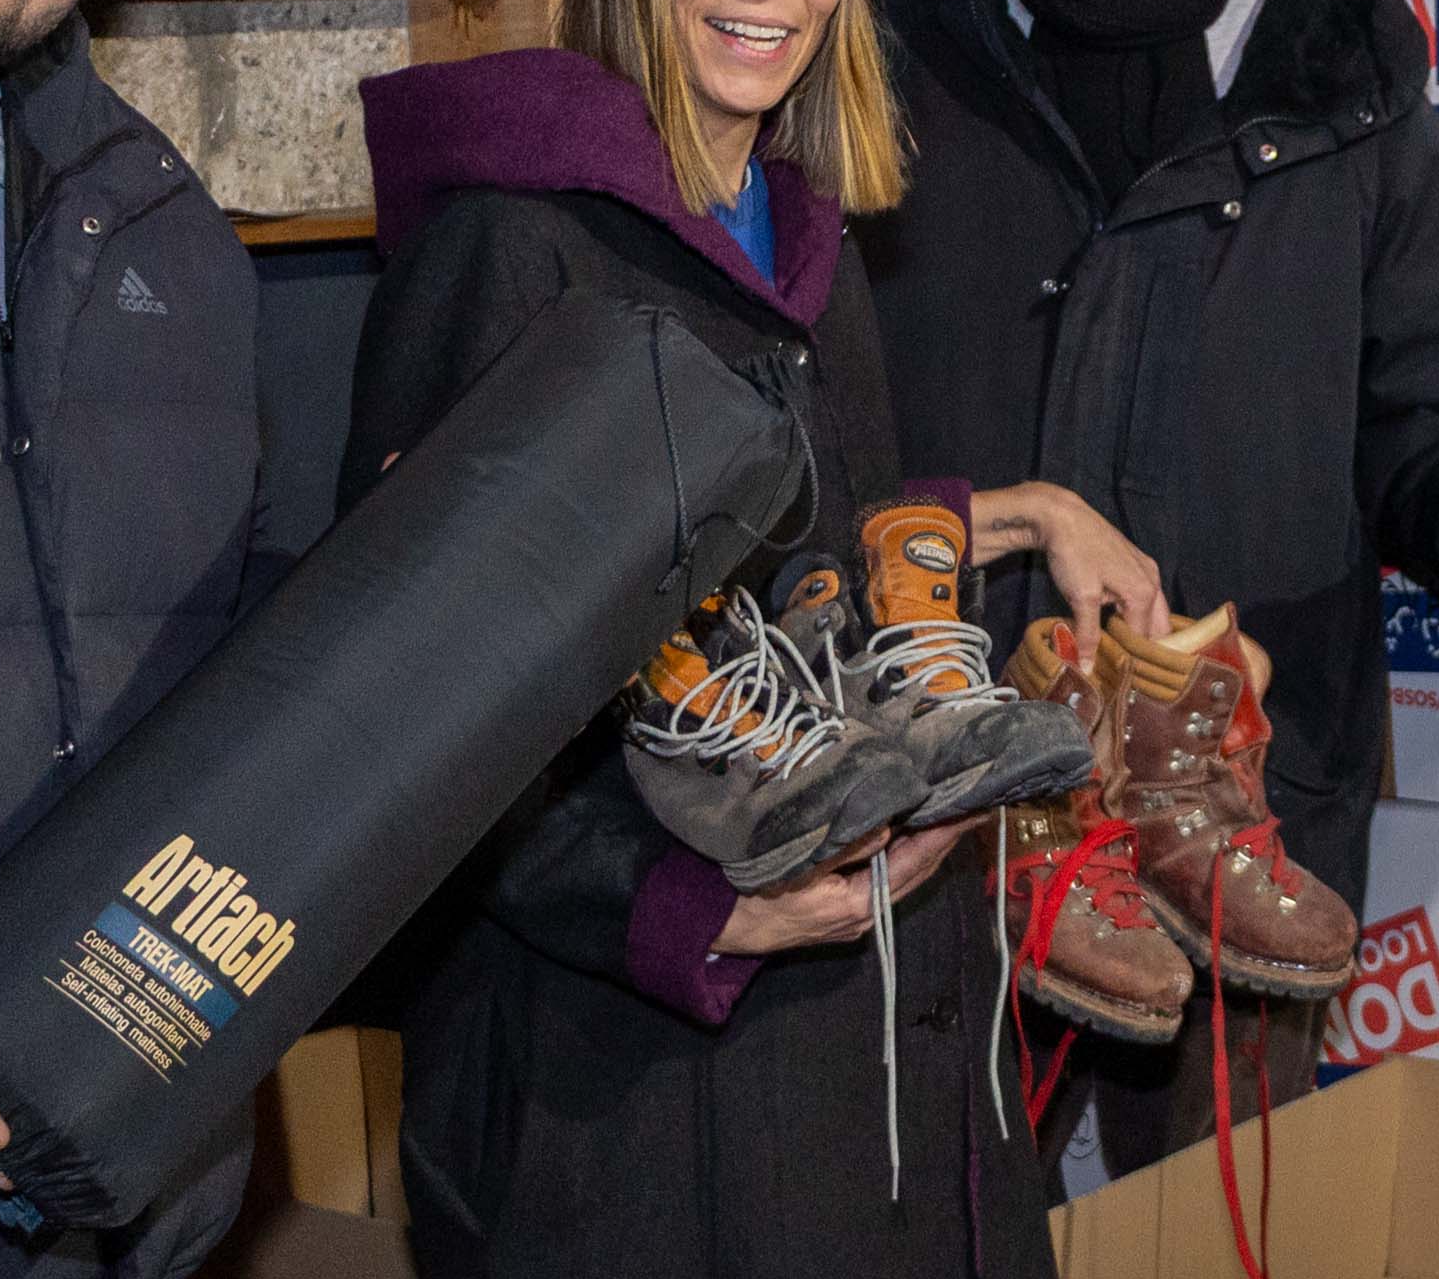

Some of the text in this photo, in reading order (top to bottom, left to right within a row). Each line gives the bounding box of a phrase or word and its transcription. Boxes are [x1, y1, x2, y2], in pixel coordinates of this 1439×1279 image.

[117, 295, 167, 315] adidas
[122, 833, 296, 998] Artiach
[79, 955, 189, 1052] Matelas autogonflant
[83, 929, 212, 1042] Colchoneta autohinchable
[128, 927, 214, 1003] TREK-MAT
[60, 971, 172, 1070] Self-inflating mattress
